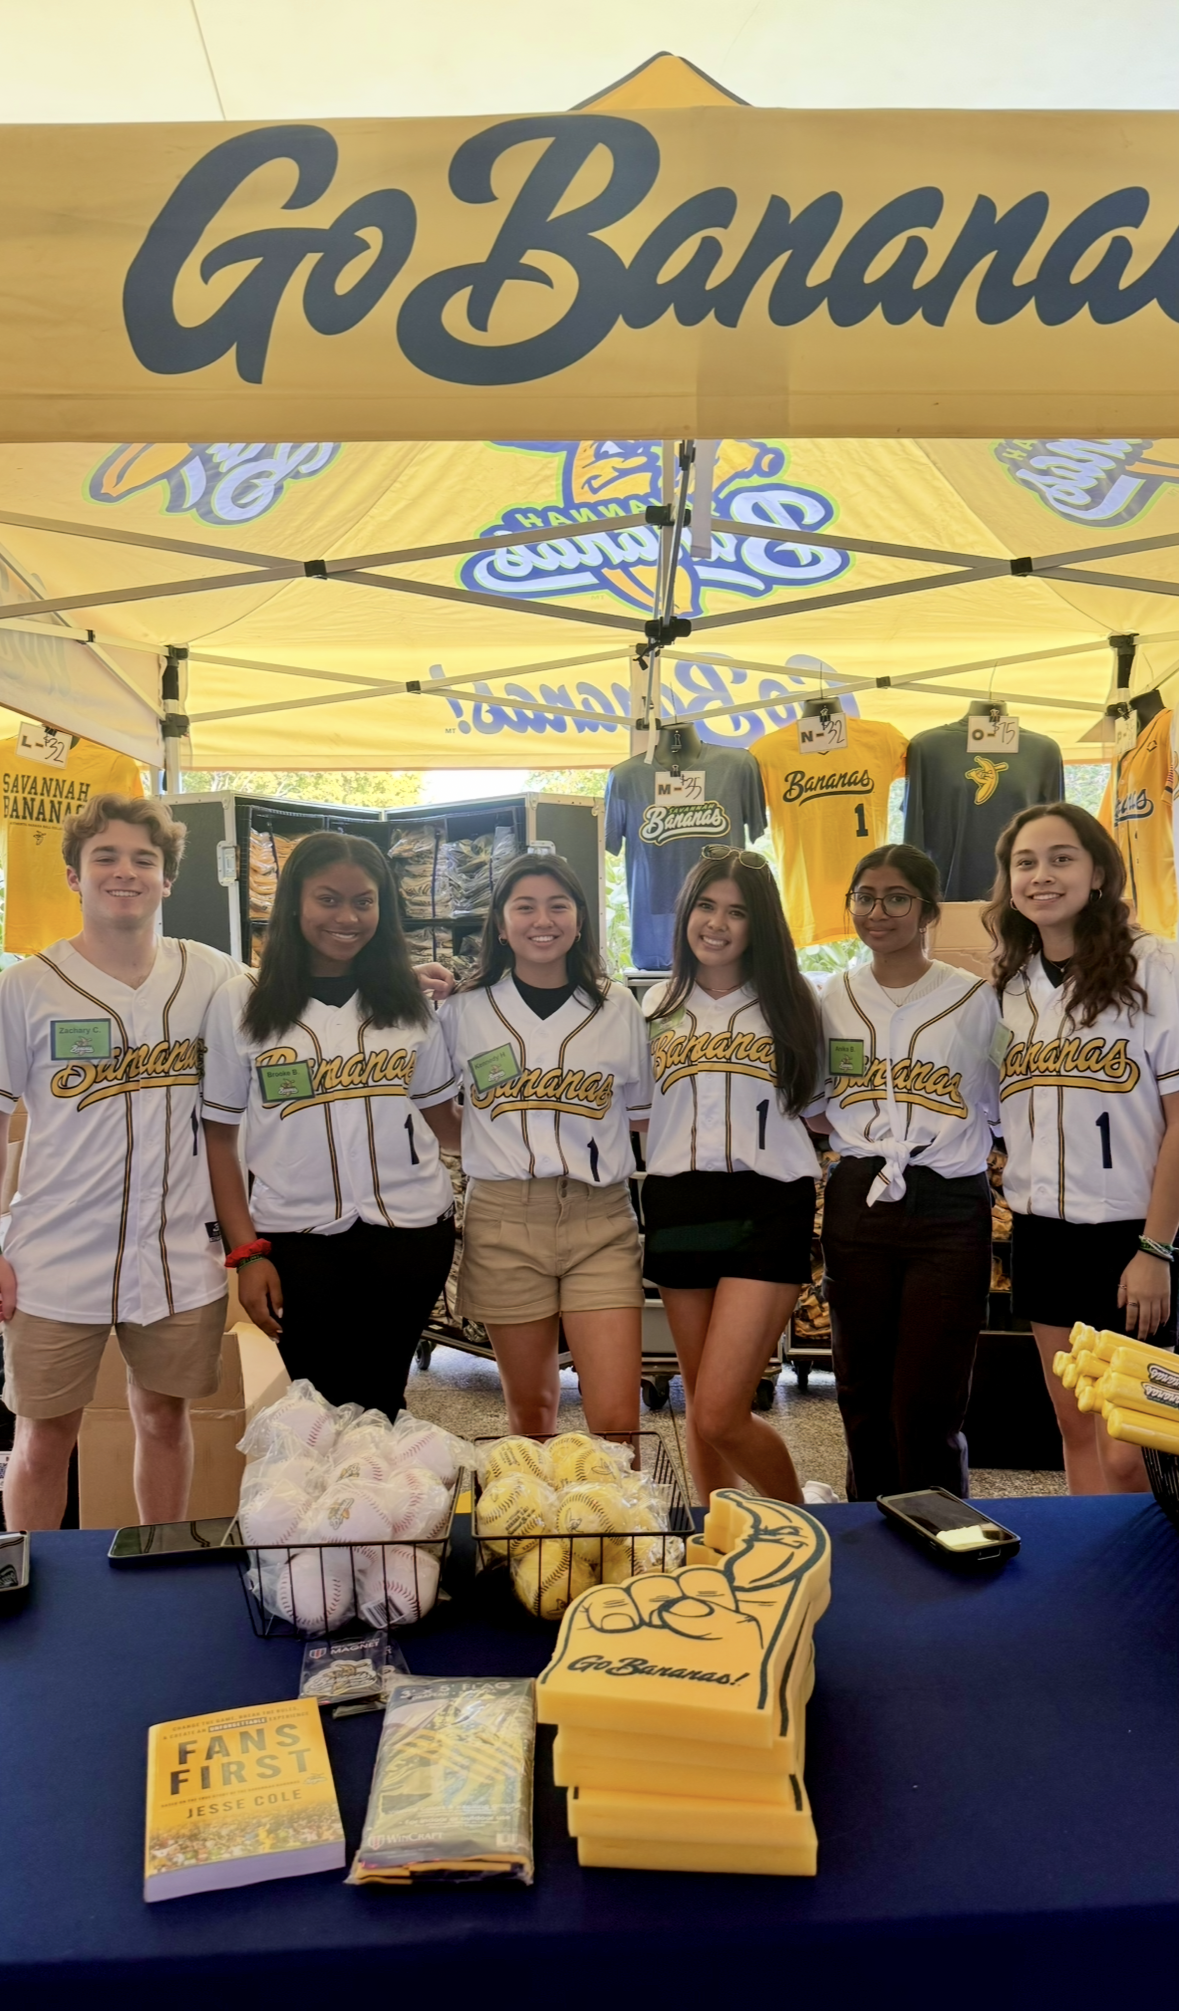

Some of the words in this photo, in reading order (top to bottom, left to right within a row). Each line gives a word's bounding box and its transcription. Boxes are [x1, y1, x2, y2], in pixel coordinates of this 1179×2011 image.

[123, 124, 417, 385] Go
[396, 114, 1179, 386] Banana
[3, 773, 91, 802] SAVANNAH
[783, 769, 875, 807] Bananas
[642, 806, 726, 842] Bananas
[669, 803, 715, 814] SAVANNAH
[855, 803, 869, 837] 1
[59, 1027, 91, 1035] Zachary
[267, 1069, 291, 1078] Brooke
[651, 1030, 779, 1089] Banana
[1000, 1034, 1140, 1095] ananas
[190, 1104, 199, 1156] 1
[404, 1113, 420, 1165] 1
[756, 1099, 770, 1150] 1
[1095, 1111, 1112, 1168] 1
[587, 1136, 600, 1182] 1
[330, 1641, 380, 1654] MAGNET
[462, 1682, 511, 1690] FLAG
[567, 1655, 613, 1672] Go
[605, 1657, 750, 1686] Bananas!
[268, 1711, 309, 1722] EXPERIENCE
[178, 1723, 301, 1765] FANS
[170, 1748, 311, 1796] FIRST
[187, 1799, 245, 1819] JESSE
[254, 1789, 302, 1806] COLE
